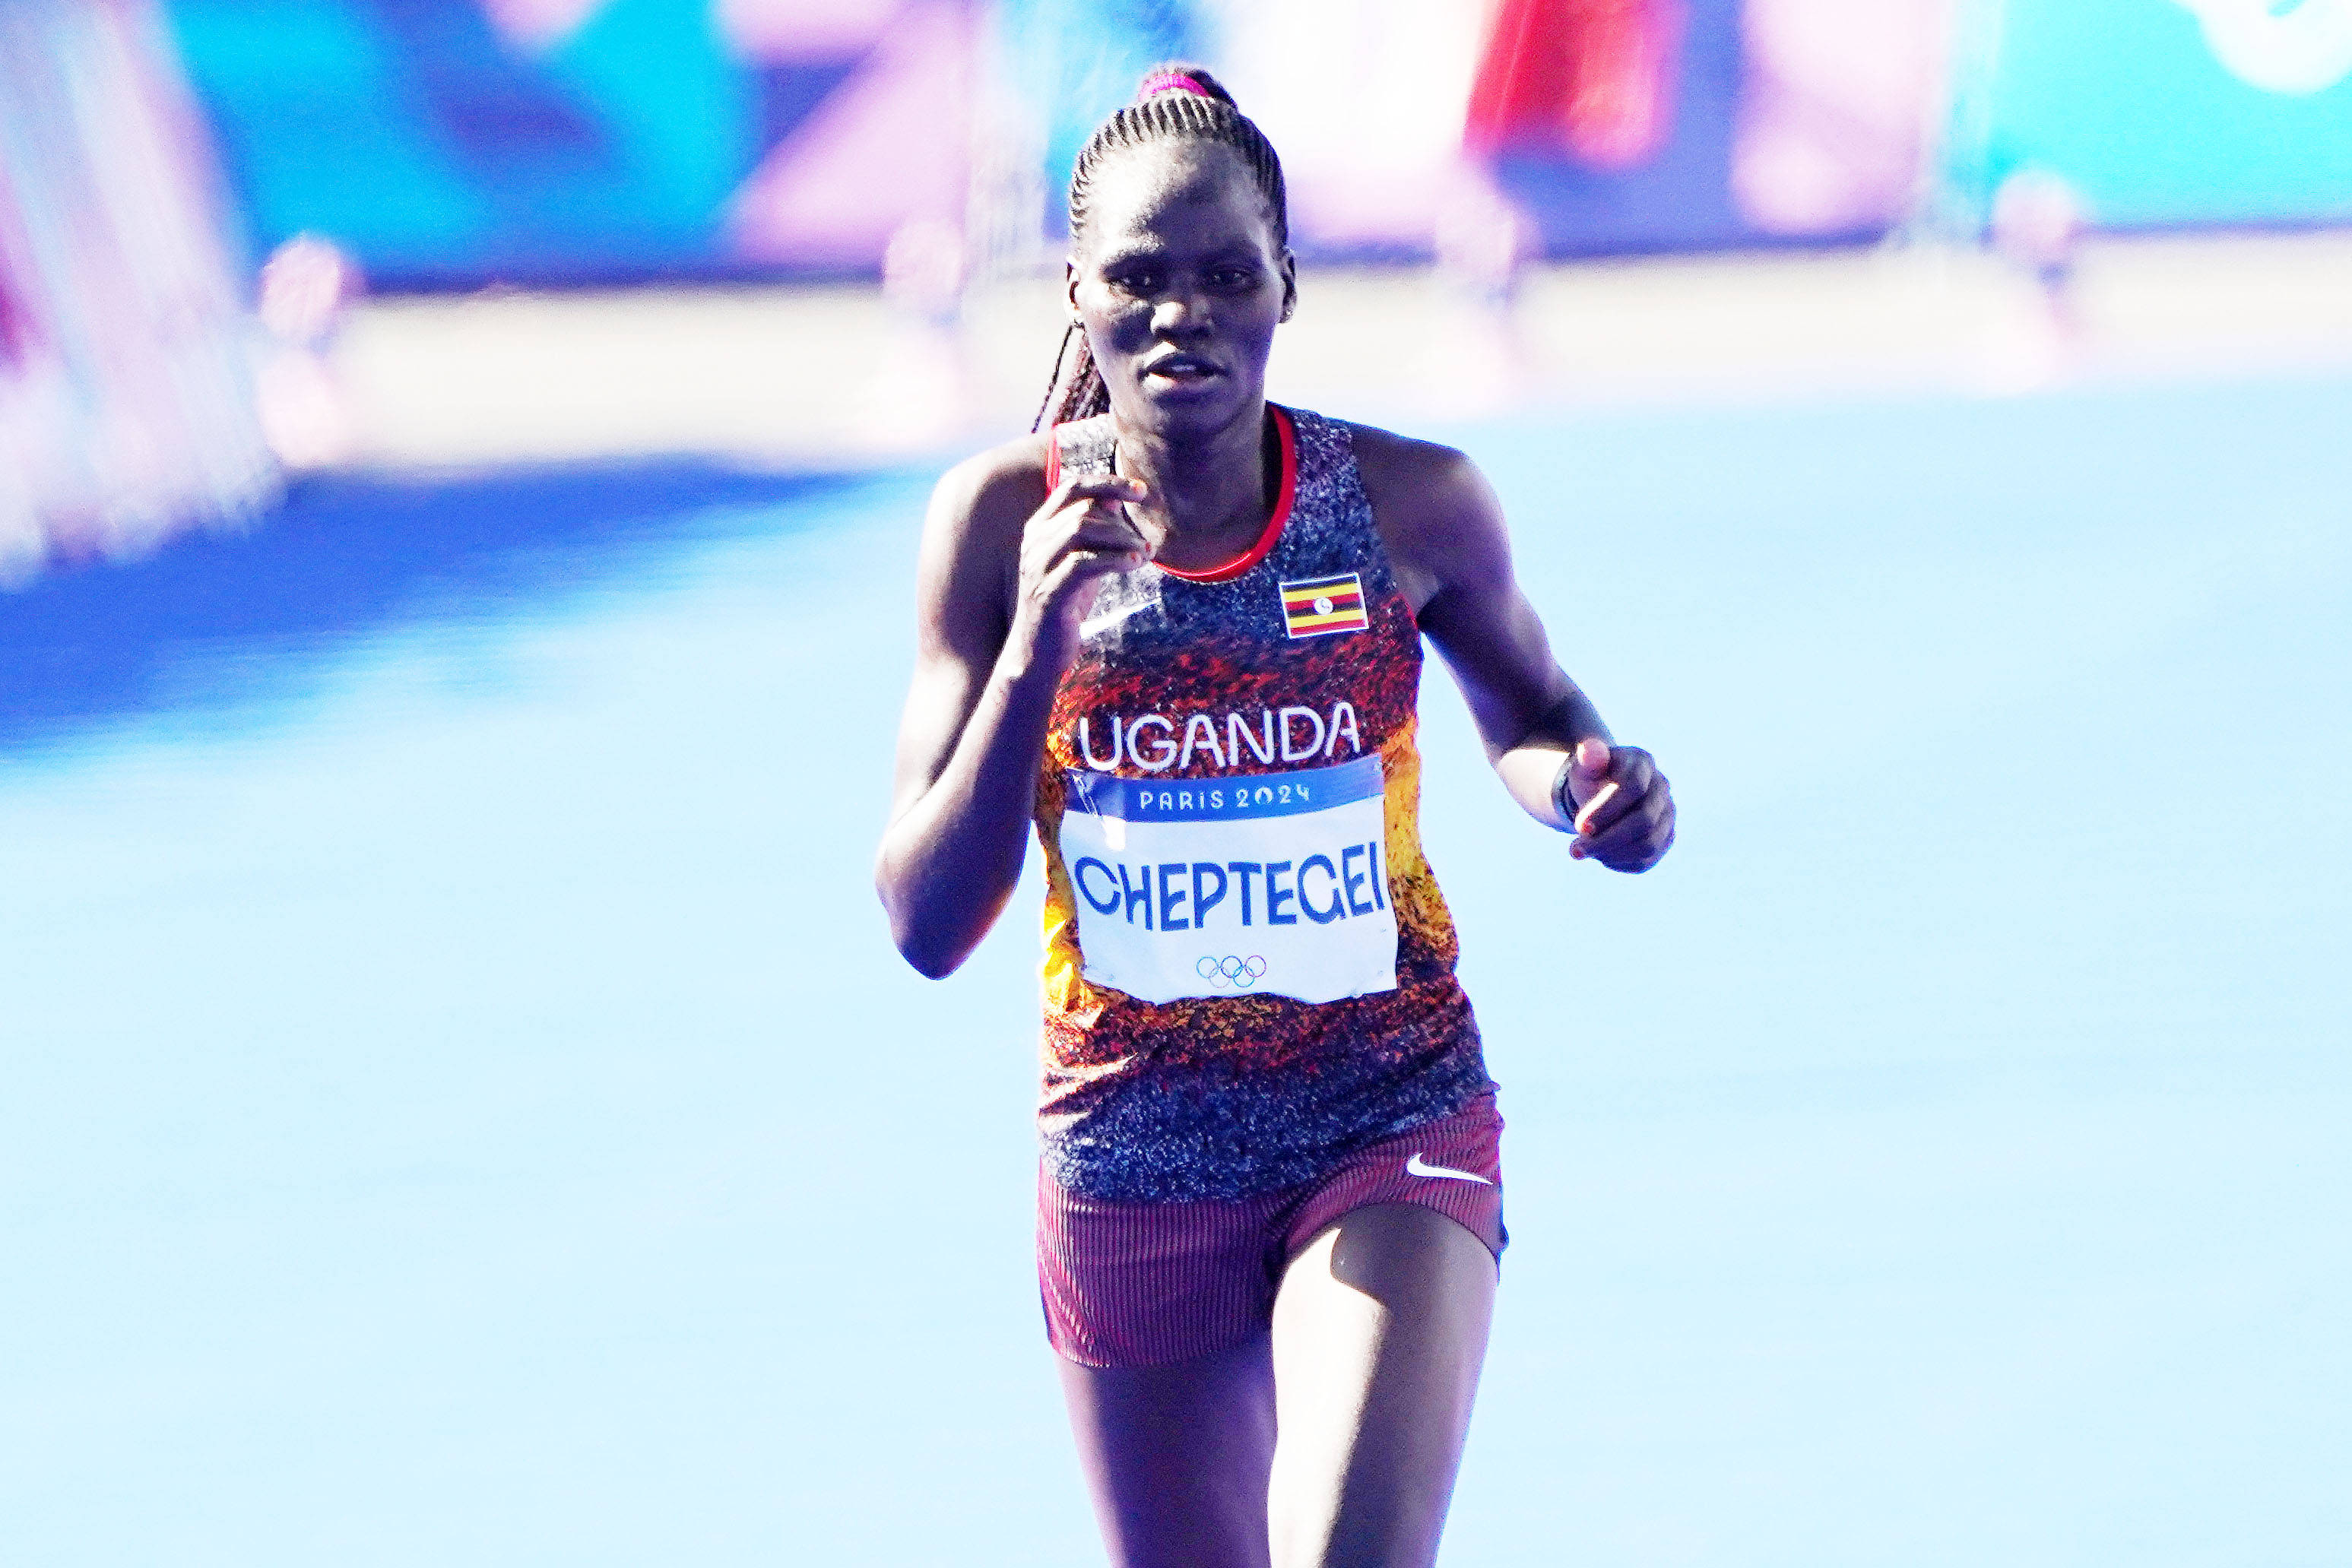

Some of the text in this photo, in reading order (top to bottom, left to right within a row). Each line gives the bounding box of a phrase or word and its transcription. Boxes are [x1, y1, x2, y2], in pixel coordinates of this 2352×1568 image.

[1079, 701, 1361, 771] UGANDA
[1236, 784, 1311, 808] 2024
[1074, 841, 1385, 932] CHEPTEGEI
